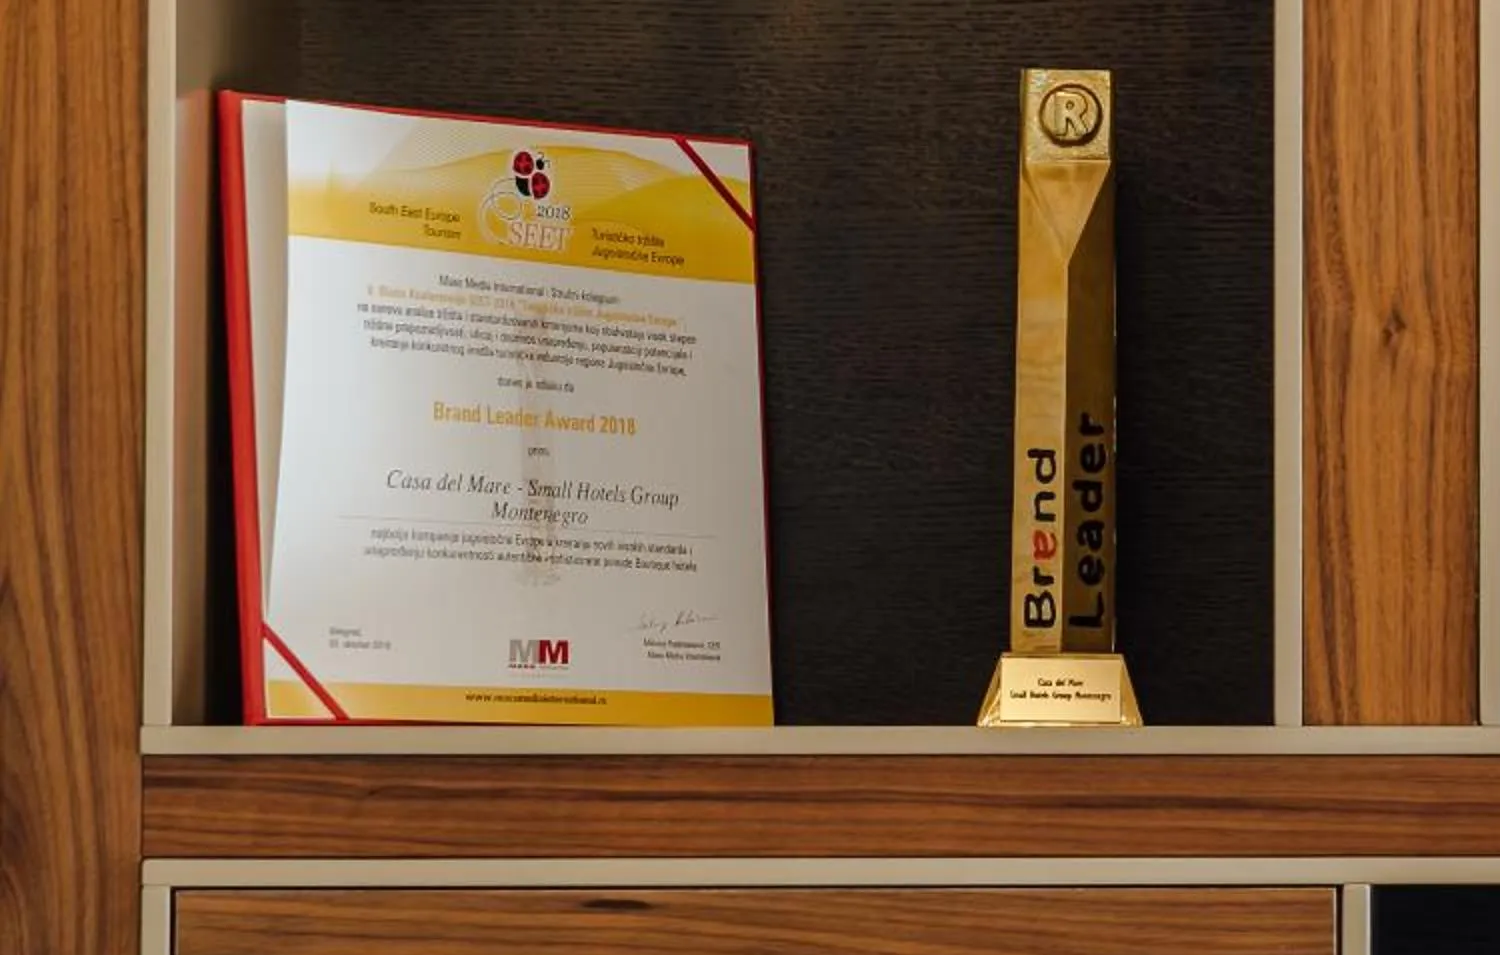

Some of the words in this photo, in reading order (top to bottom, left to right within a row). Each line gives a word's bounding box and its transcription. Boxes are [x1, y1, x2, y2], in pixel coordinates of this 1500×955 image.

[433, 401, 481, 423] Brand
[487, 403, 539, 428] Leader
[544, 408, 596, 433] Award
[599, 415, 637, 436] 2018
[386, 469, 432, 492] Casa
[436, 472, 463, 494] del
[467, 475, 513, 496] Mare
[527, 478, 572, 500] Small
[577, 482, 626, 504] Hotels
[631, 485, 680, 510] Group
[491, 501, 590, 526] Montenegro
[1069, 411, 1105, 630] Leader
